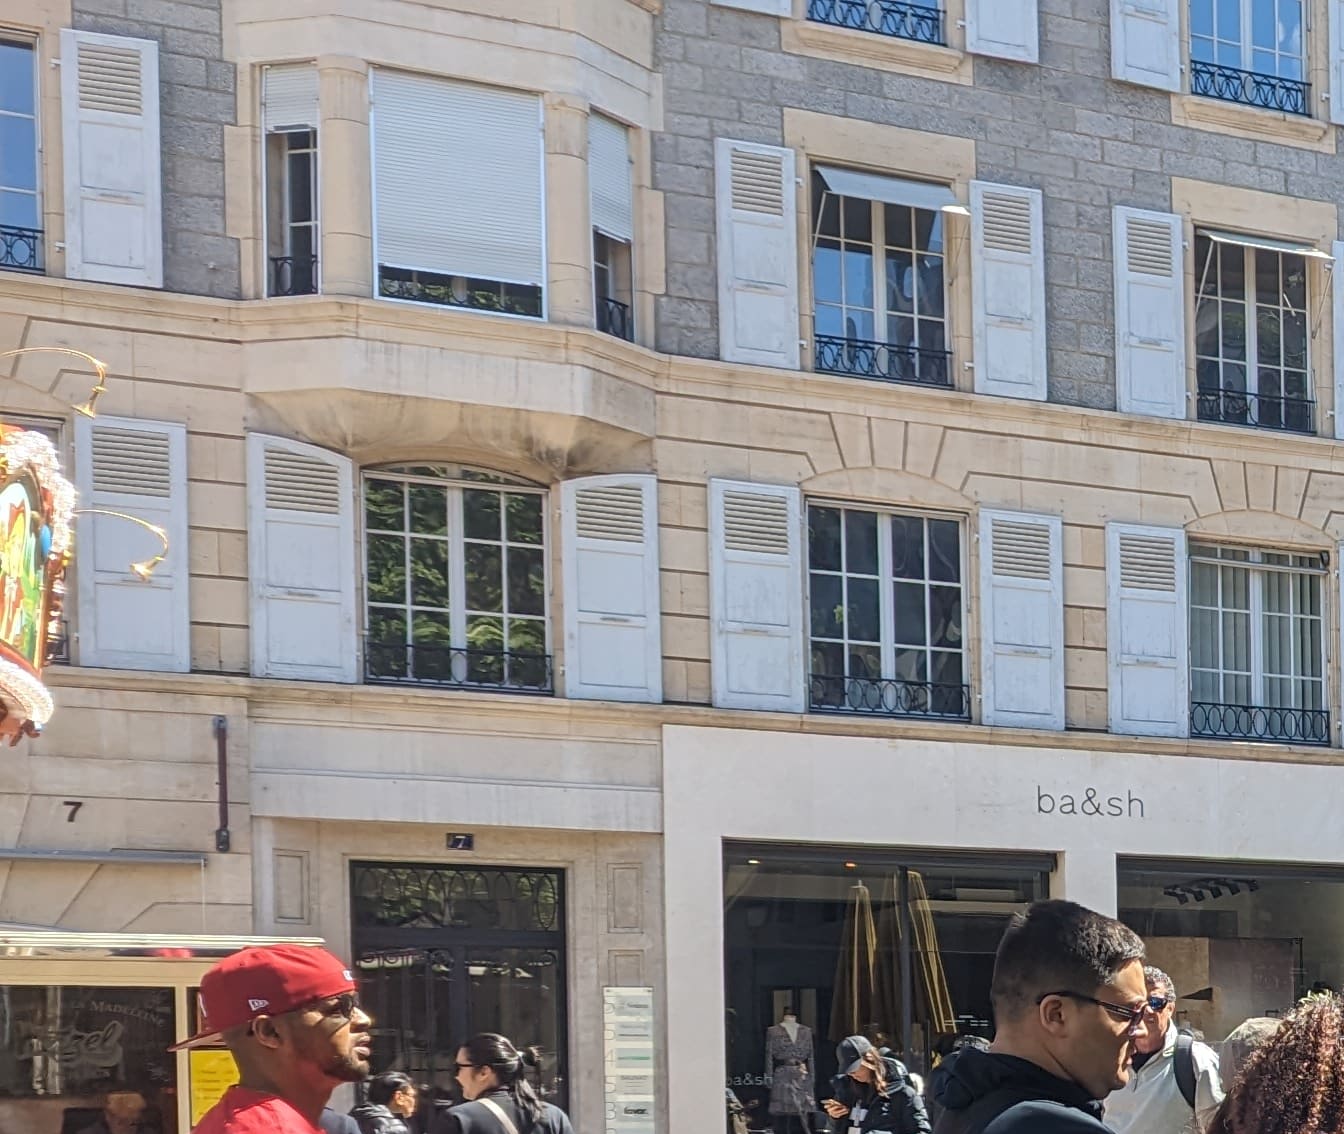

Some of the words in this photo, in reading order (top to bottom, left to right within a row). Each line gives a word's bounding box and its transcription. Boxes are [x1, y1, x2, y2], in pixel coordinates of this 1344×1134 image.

[63, 801, 82, 822] 7
[1038, 785, 1144, 817] ba&sh
[454, 835, 467, 849] 7
